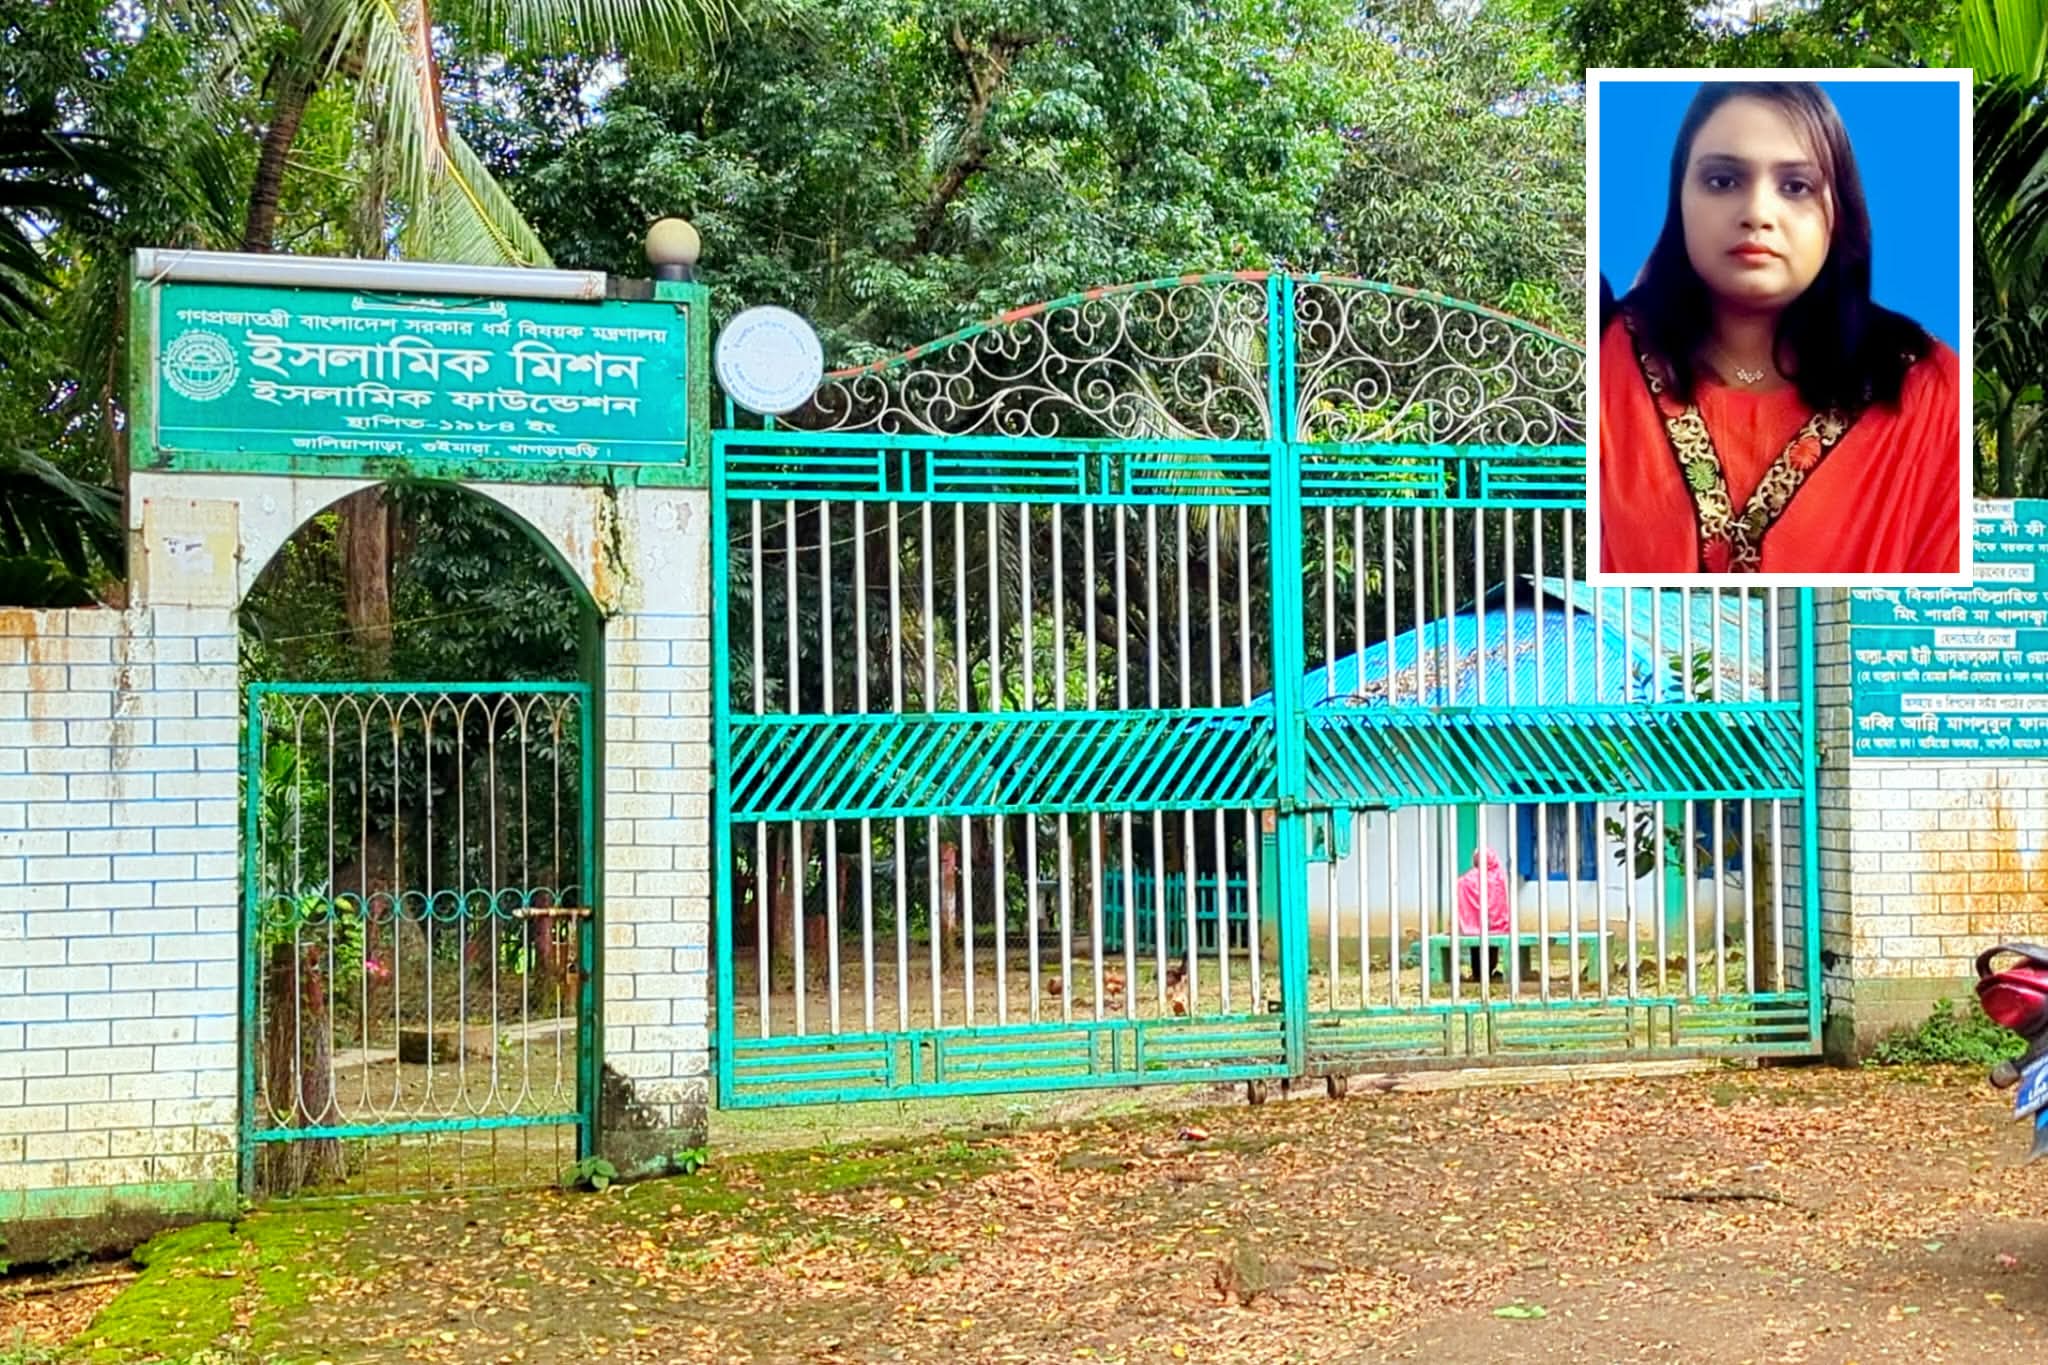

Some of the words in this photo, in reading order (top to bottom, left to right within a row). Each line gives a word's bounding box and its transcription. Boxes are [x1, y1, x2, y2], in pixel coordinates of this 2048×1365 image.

[300, 315, 398, 334] বাংলাদেশ
[403, 319, 473, 336] সরকার
[482, 320, 512, 338] ধর্ম
[517, 320, 584, 341] বিষয়ক
[243, 329, 495, 382] ইসলামিক
[506, 340, 646, 389] মিশন
[248, 378, 436, 409] ইসলামিক
[445, 387, 641, 417] ফাউন্ডেশন
